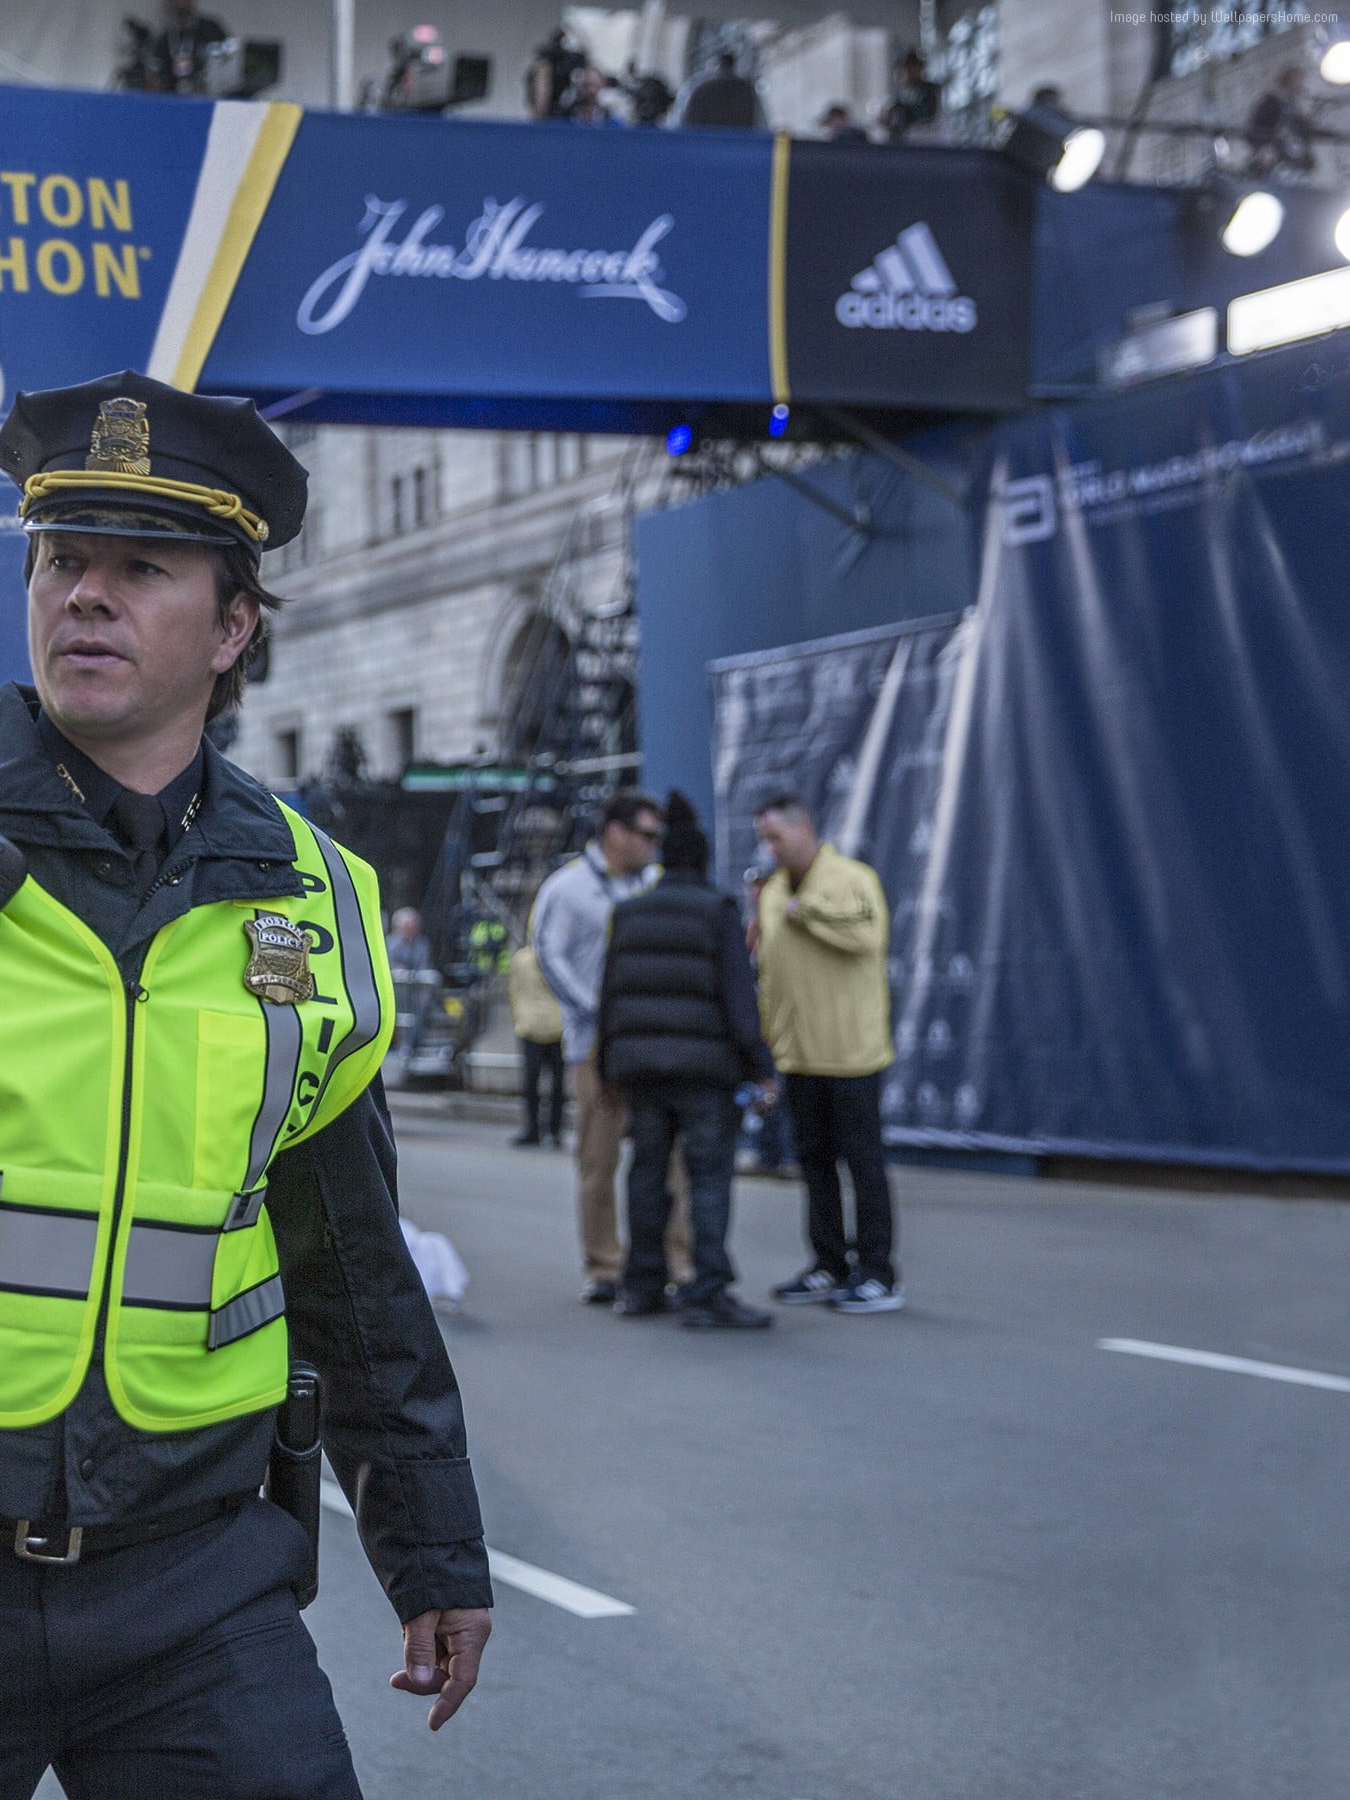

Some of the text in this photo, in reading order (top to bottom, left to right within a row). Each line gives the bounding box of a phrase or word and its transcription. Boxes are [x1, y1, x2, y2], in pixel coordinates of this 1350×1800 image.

[296, 193, 688, 336] John Hancock
[834, 291, 979, 334] adidas
[254, 916, 307, 940] BOSTON
[261, 932, 305, 951] POLICE
[286, 871, 339, 1134] POLIC
